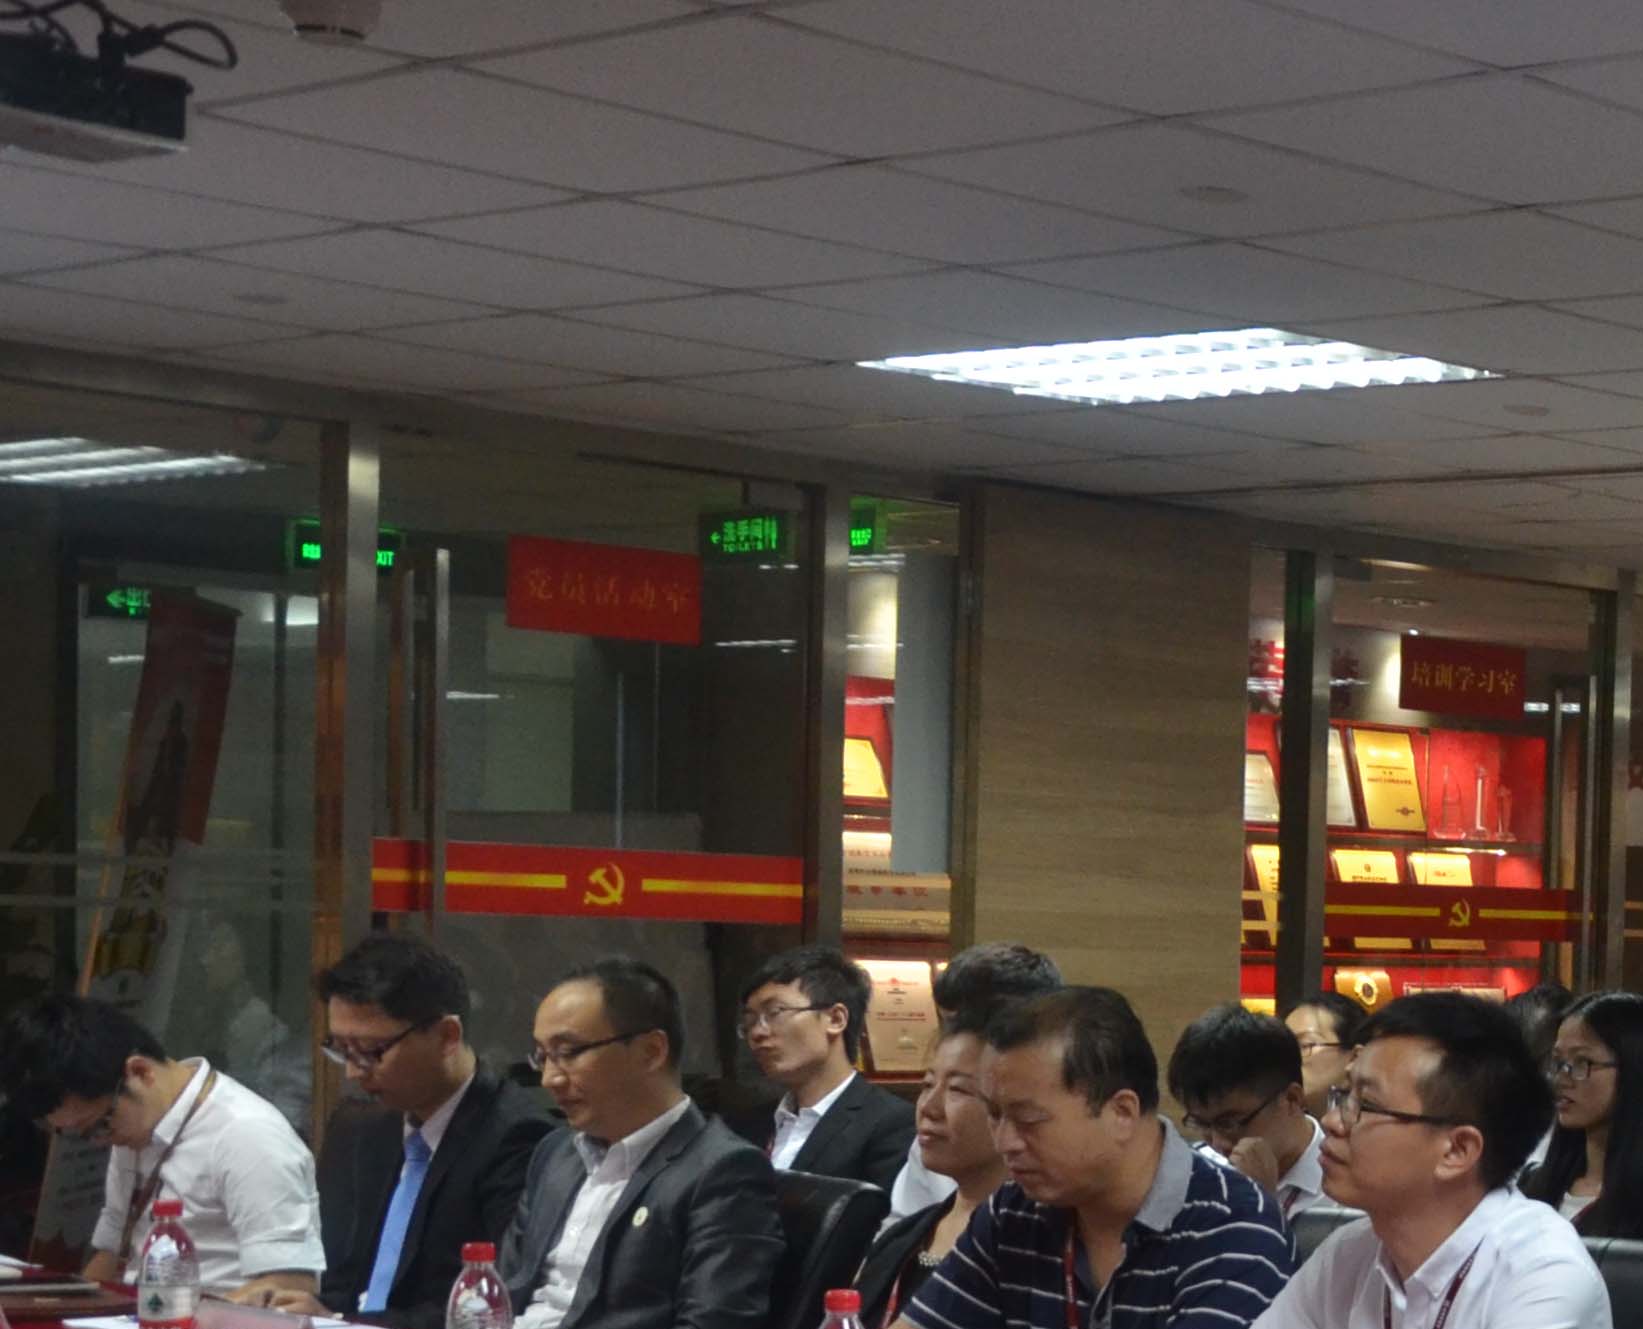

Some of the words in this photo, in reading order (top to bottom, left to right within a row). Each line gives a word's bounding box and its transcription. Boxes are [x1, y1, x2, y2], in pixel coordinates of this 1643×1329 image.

[723, 518, 763, 542] 洗手间
[376, 550, 395, 567] XIT
[1410, 660, 1517, 696] 培训学习室
